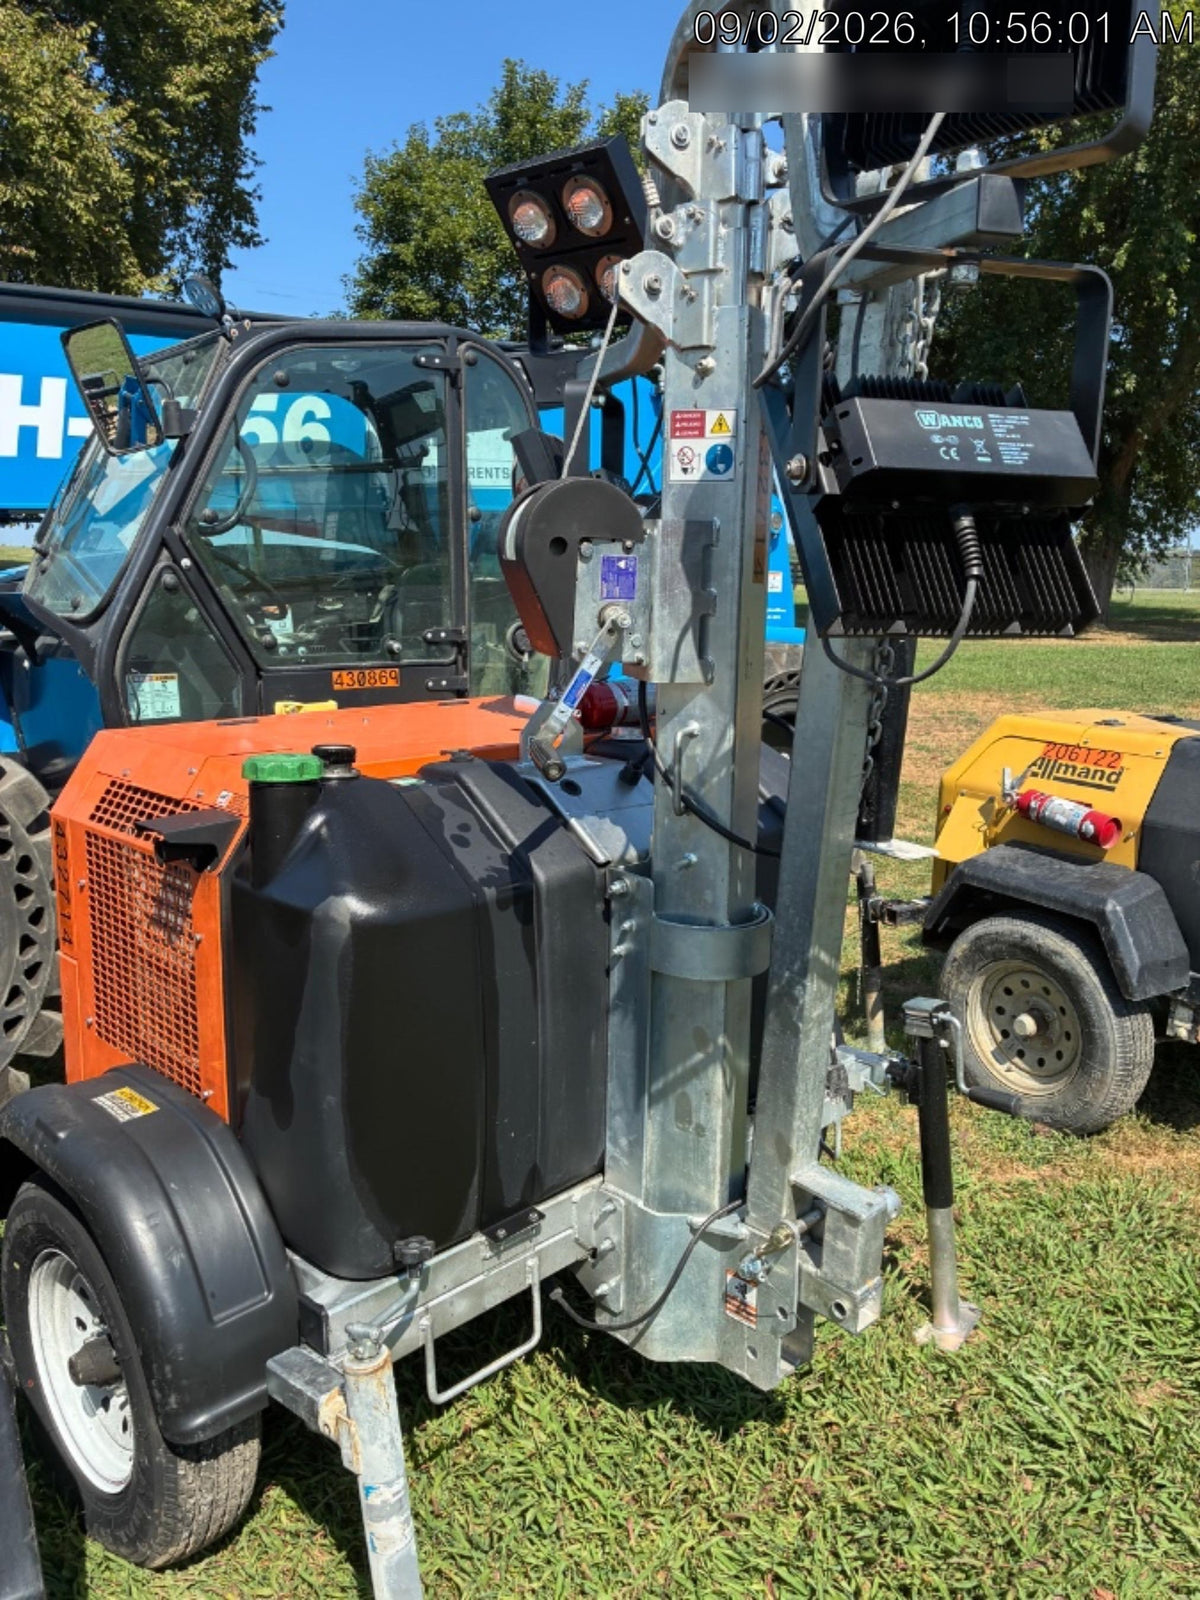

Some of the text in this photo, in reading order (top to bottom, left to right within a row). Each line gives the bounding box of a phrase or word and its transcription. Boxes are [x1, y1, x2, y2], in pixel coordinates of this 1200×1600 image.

[914, 410, 984, 429] WANCO
[467, 466, 510, 479] RENTS
[334, 669, 399, 688] 430869
[1027, 757, 1124, 784] Allmand
[55, 821, 73, 945] 432714
